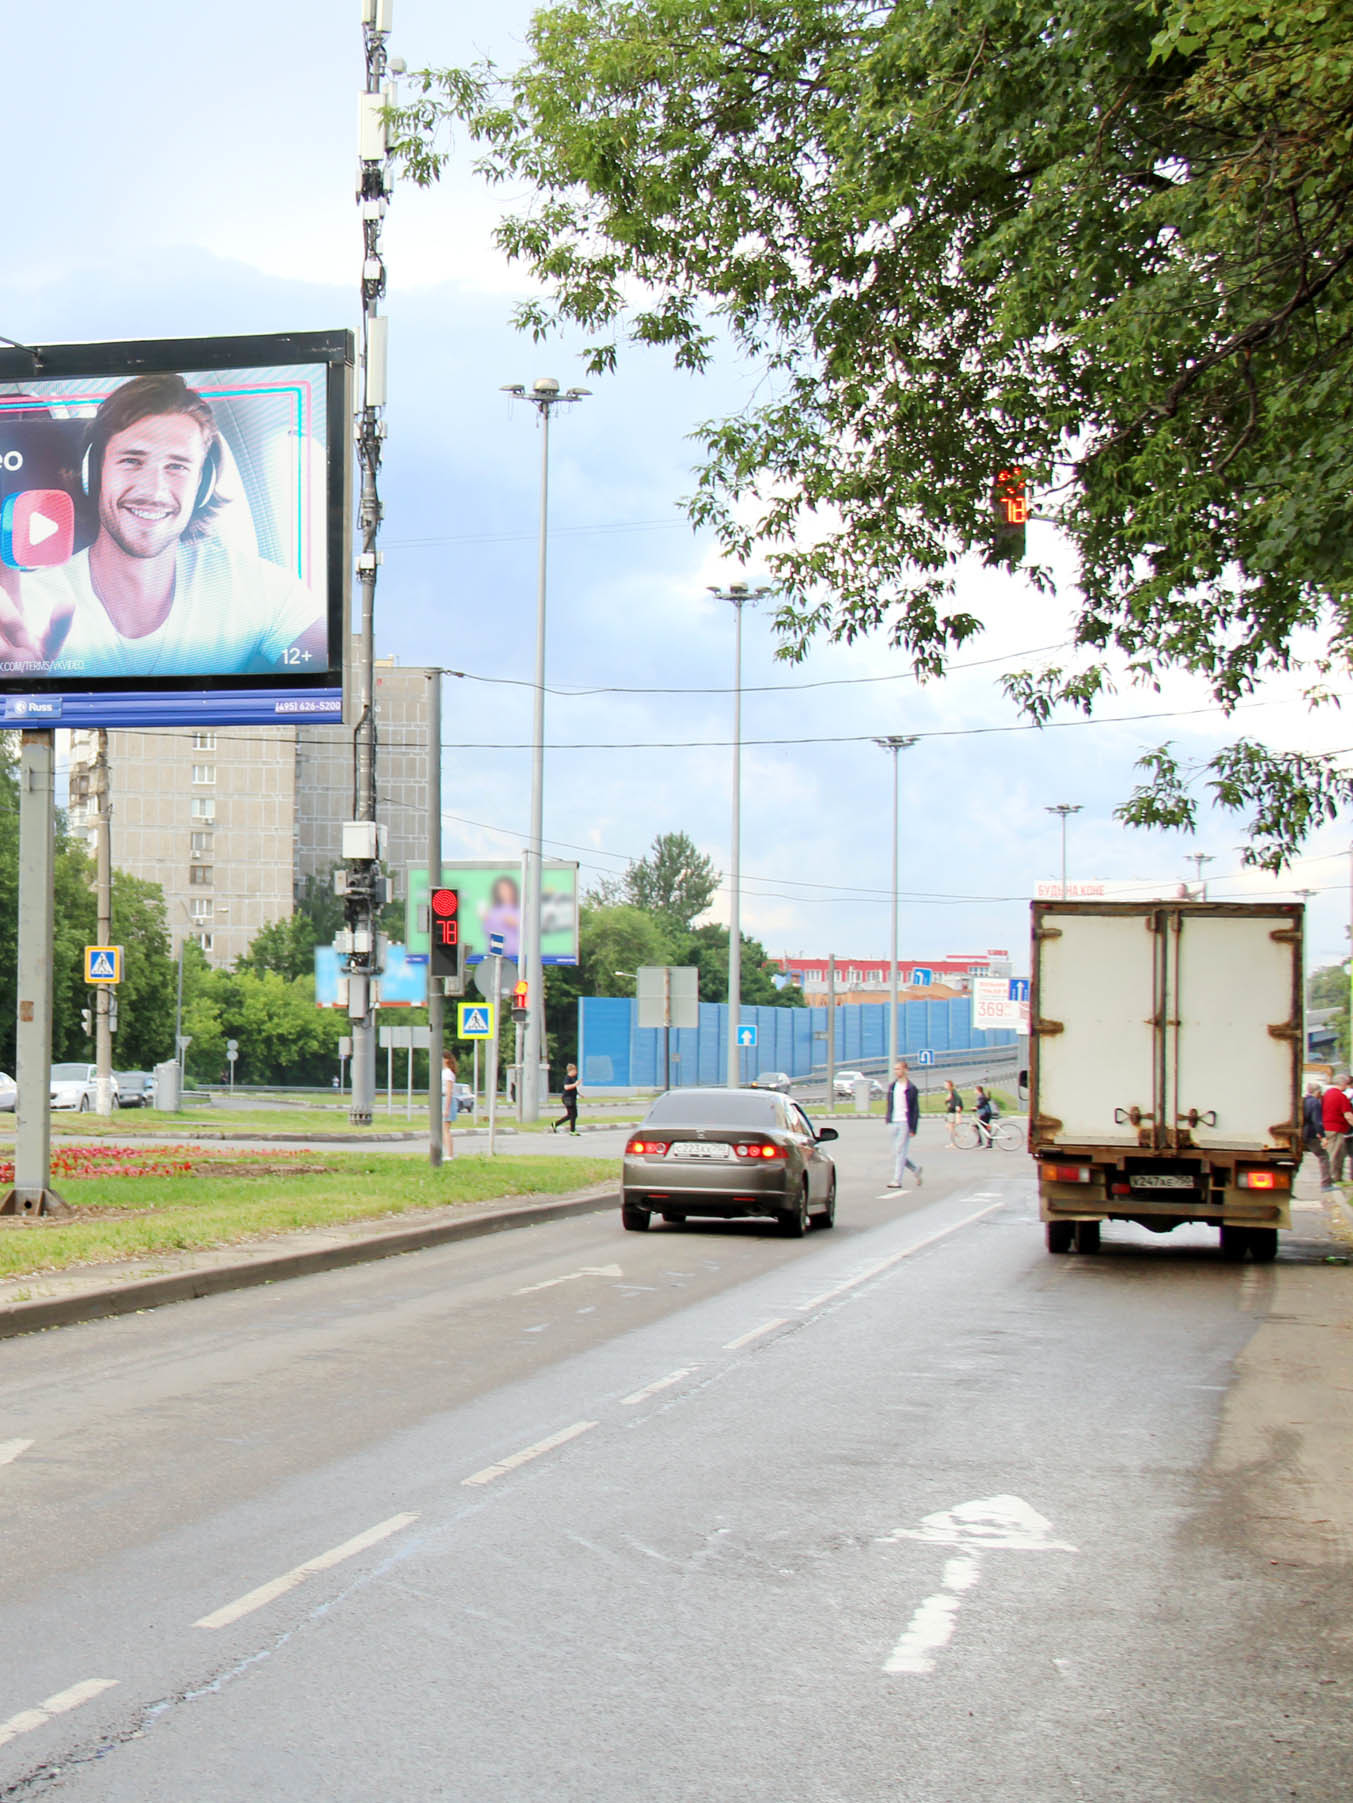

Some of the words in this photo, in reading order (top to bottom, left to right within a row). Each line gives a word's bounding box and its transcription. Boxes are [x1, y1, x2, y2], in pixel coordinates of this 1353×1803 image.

[281, 647, 313, 665] 12+
[28, 702, 54, 712] Russ
[275, 701, 298, 713] (495)
[299, 701, 342, 712] 626-5200
[436, 919, 458, 945] 78
